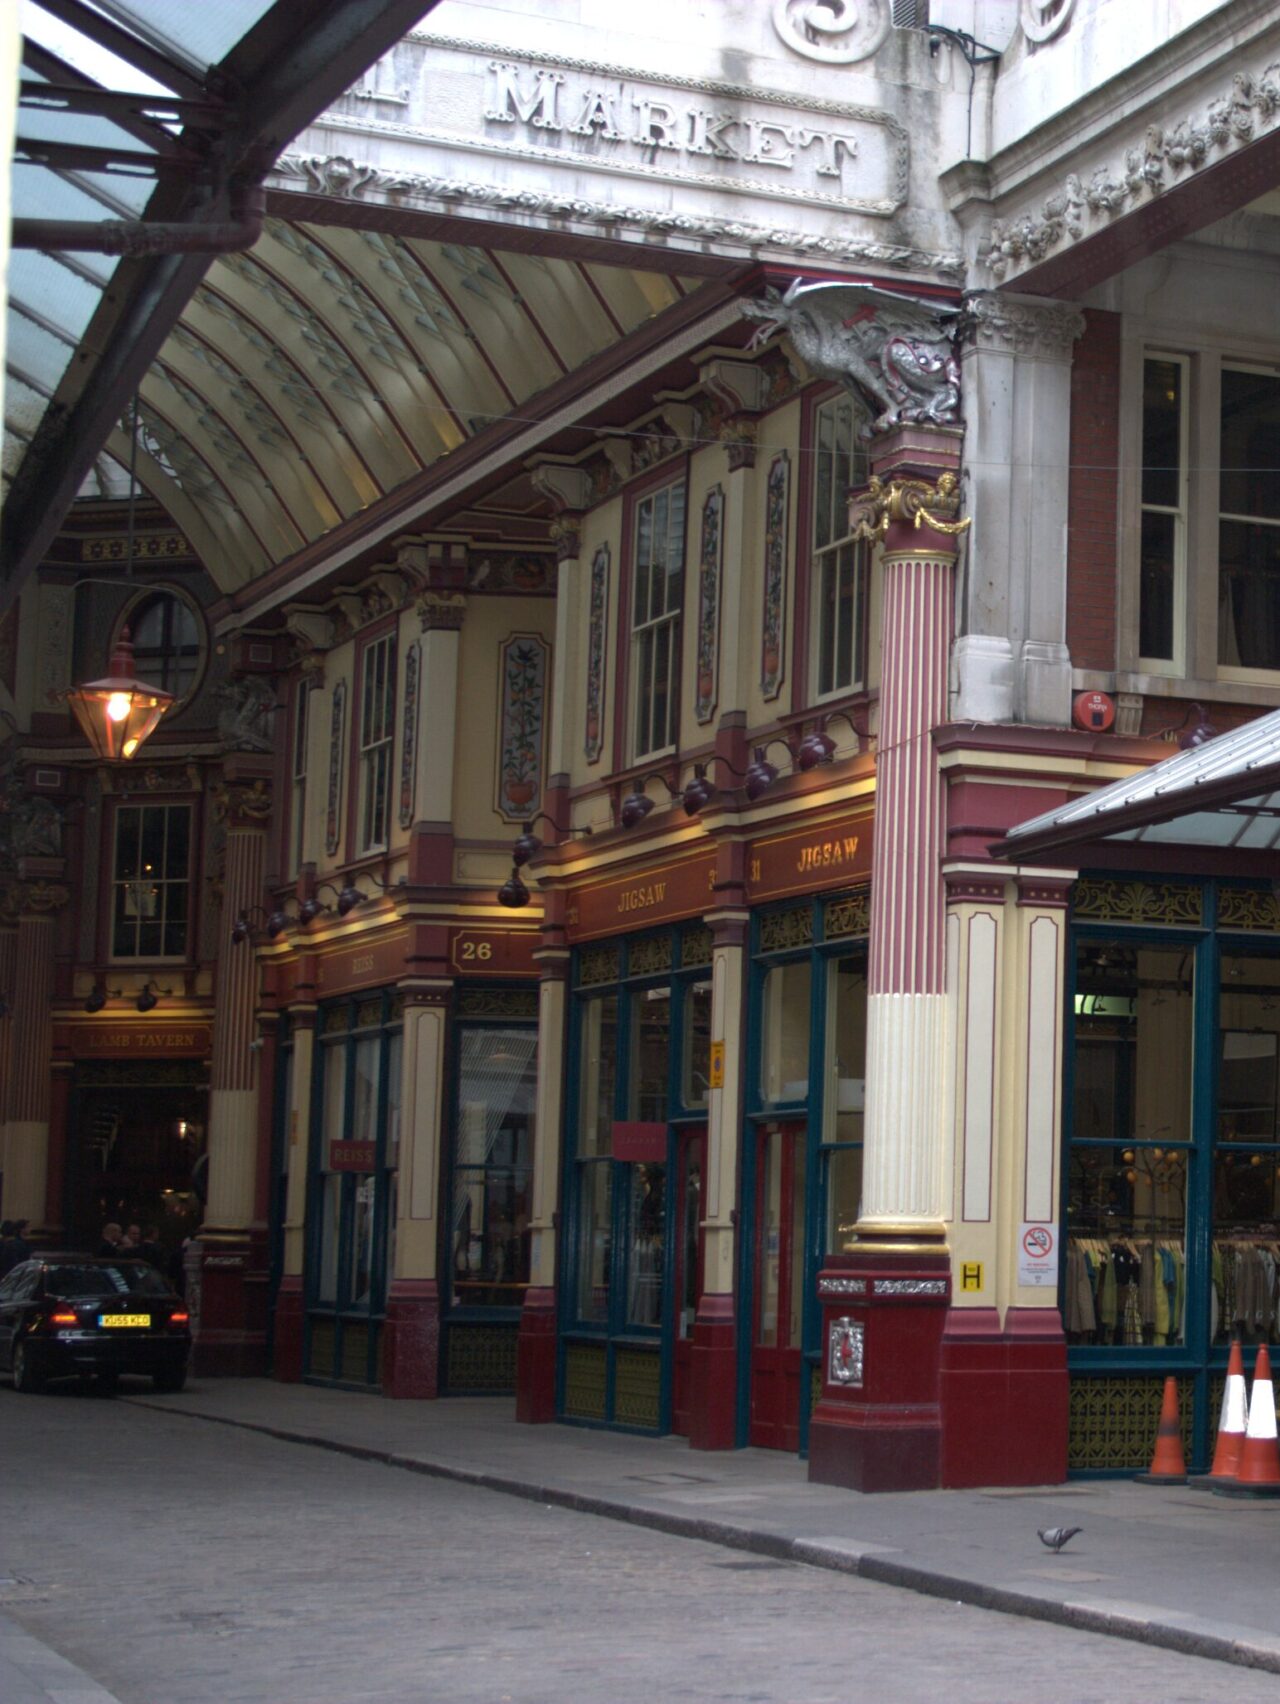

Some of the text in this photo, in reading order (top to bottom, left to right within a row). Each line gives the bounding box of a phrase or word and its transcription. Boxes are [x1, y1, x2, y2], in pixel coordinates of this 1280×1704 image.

[484, 60, 858, 178] MARKET
[752, 836, 859, 882] 31 JIGSAW
[617, 882, 667, 913] JIGSAW
[461, 942, 492, 961] 26
[135, 1033, 195, 1048] TAVERN
[335, 1148, 373, 1163] REISS
[963, 1264, 980, 1289] H
